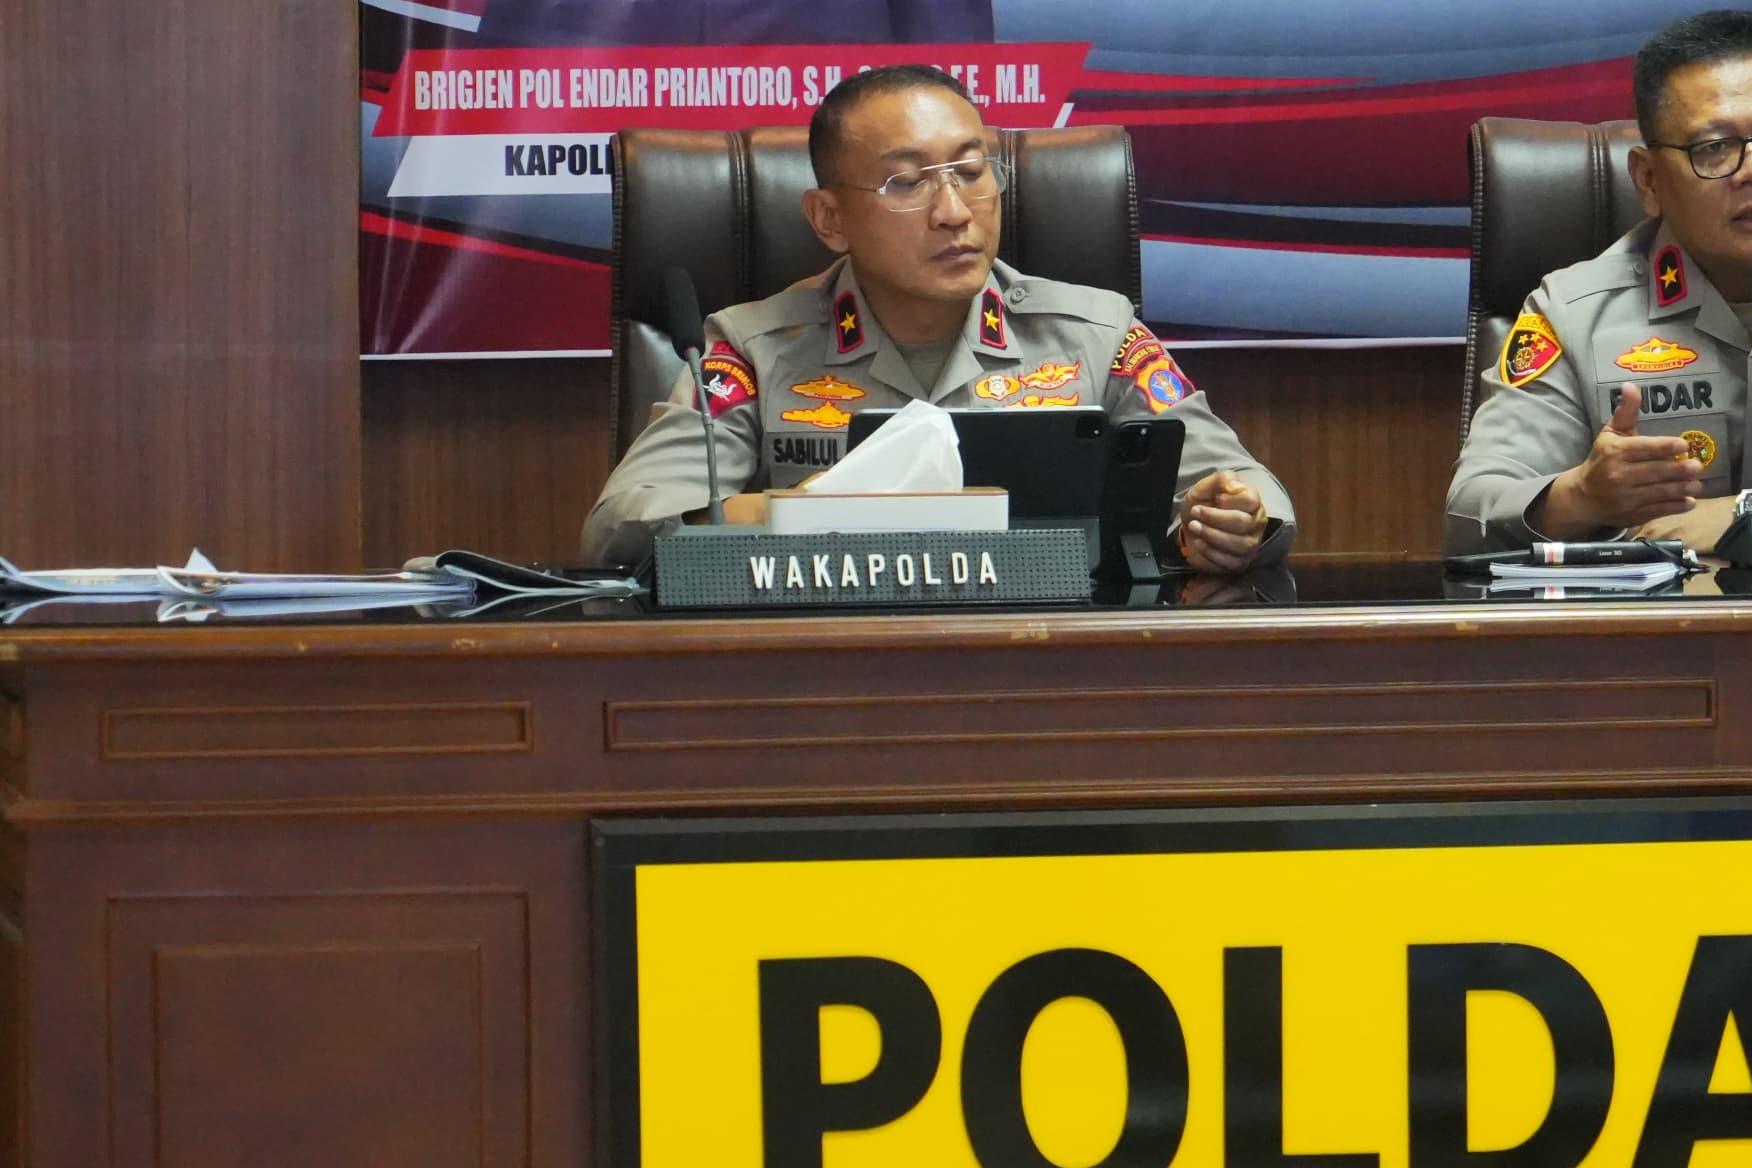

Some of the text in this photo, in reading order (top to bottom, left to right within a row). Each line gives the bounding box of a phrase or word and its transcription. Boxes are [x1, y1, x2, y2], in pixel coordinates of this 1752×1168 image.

[414, 69, 513, 110] BRIGJEN
[519, 69, 565, 109] POL
[569, 67, 648, 108] ENDAR
[654, 65, 798, 110] PRIANTORO,
[995, 63, 1046, 104] M.H.
[505, 144, 614, 176] KAPOL
[704, 361, 732, 372] KORPS
[1111, 328, 1147, 370] POLDA
[750, 551, 998, 589] WAKAPOLDA
